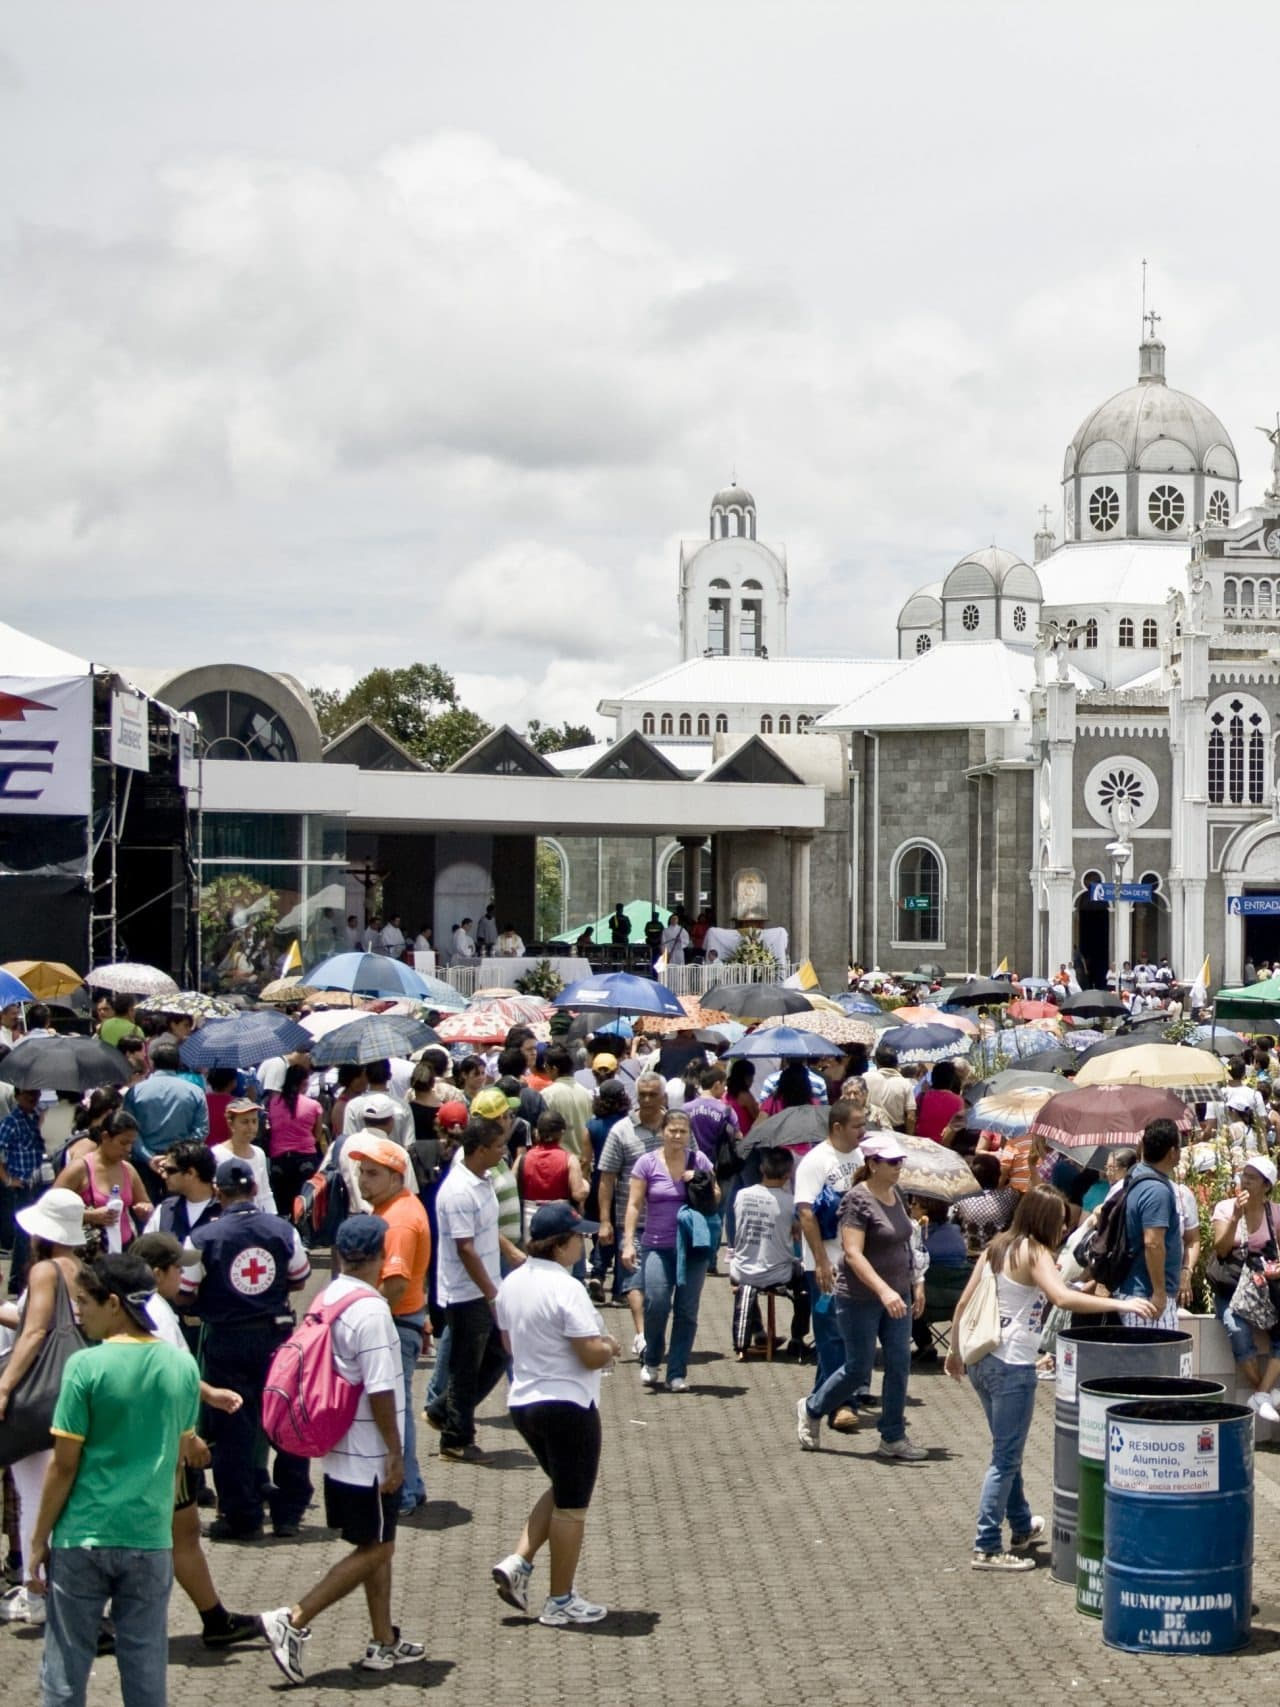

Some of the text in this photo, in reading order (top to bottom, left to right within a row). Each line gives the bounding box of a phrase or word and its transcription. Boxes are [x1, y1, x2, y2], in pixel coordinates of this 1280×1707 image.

[1128, 1440, 1185, 1452] RESIDUOS
[1132, 1453, 1181, 1466] Aluminio,
[1151, 1468, 1180, 1479] Tetra
[1182, 1467, 1209, 1478] Pack
[1120, 1590, 1232, 1611] MUNICIPALIDAD
[1163, 1613, 1187, 1630] DE
[1138, 1628, 1212, 1646] CARTAGO
